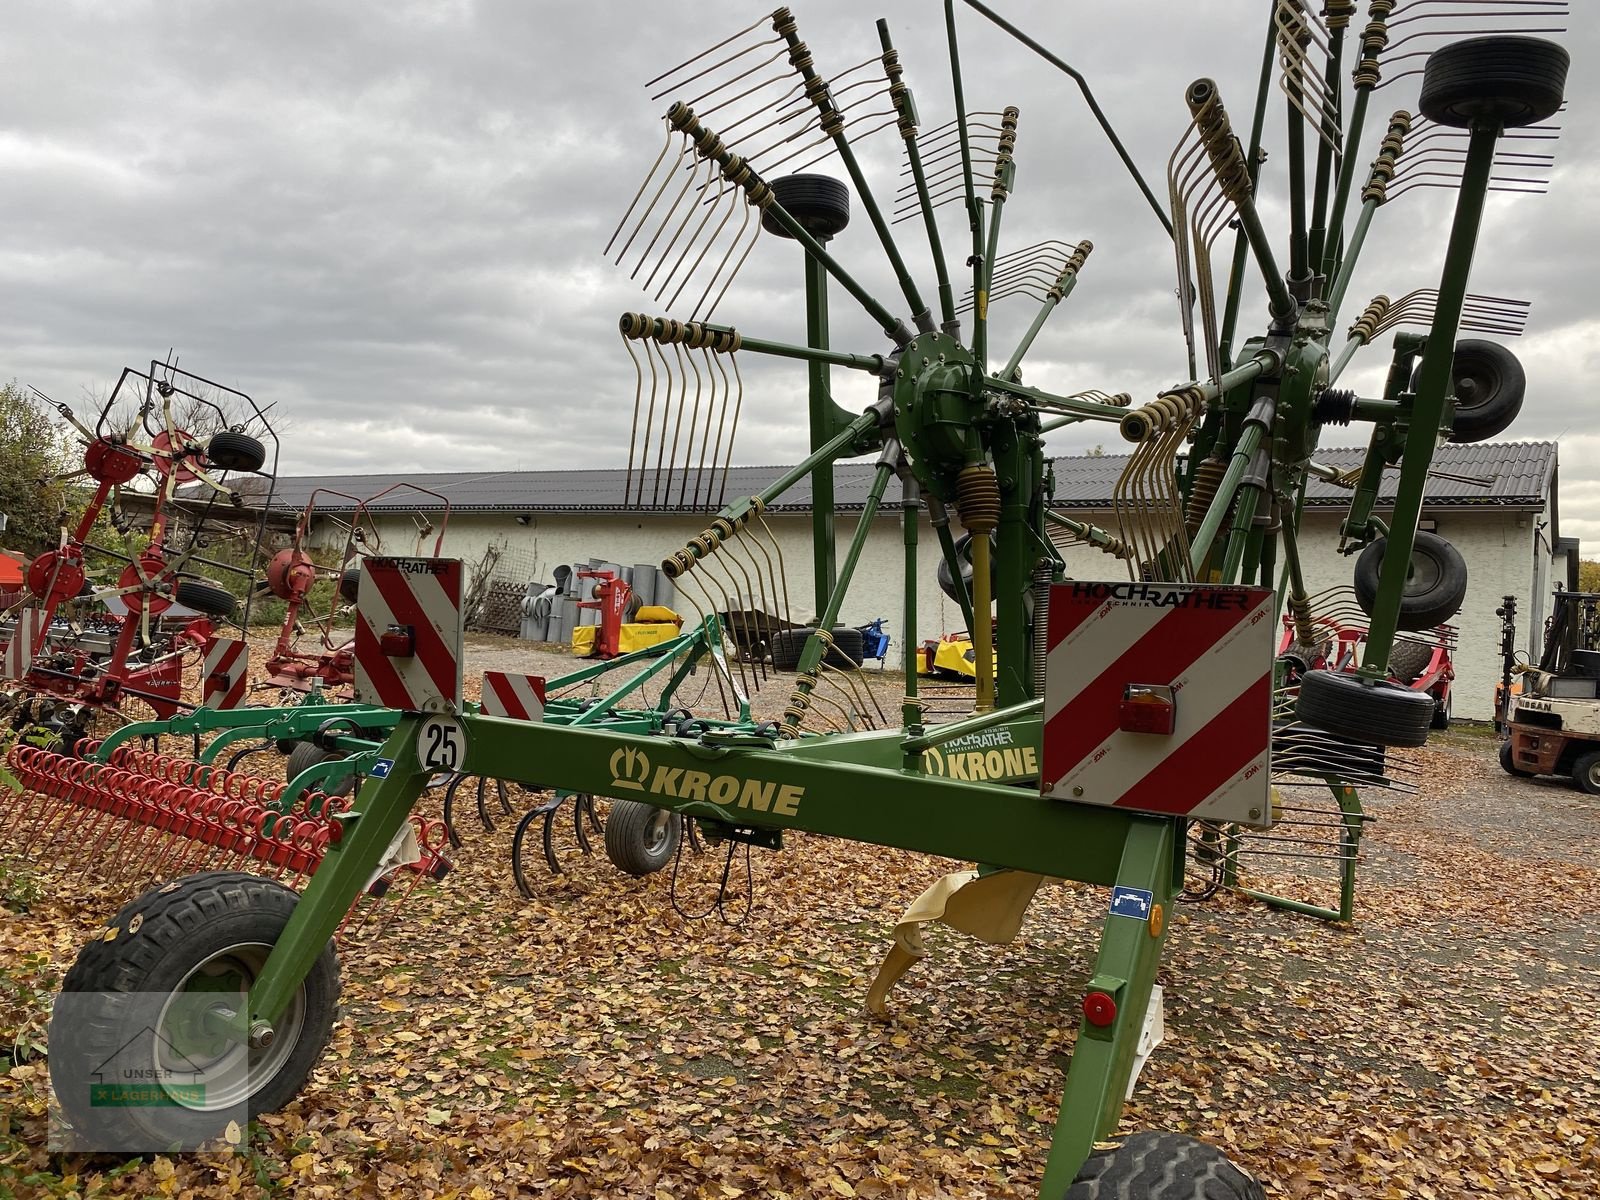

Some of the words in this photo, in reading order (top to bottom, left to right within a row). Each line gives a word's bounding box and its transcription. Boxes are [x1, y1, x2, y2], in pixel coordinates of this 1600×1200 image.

[1072, 582, 1250, 611] HOCHRATHER
[425, 723, 458, 769] 25
[946, 746, 1039, 782] KRONE
[650, 765, 806, 817] KRONE
